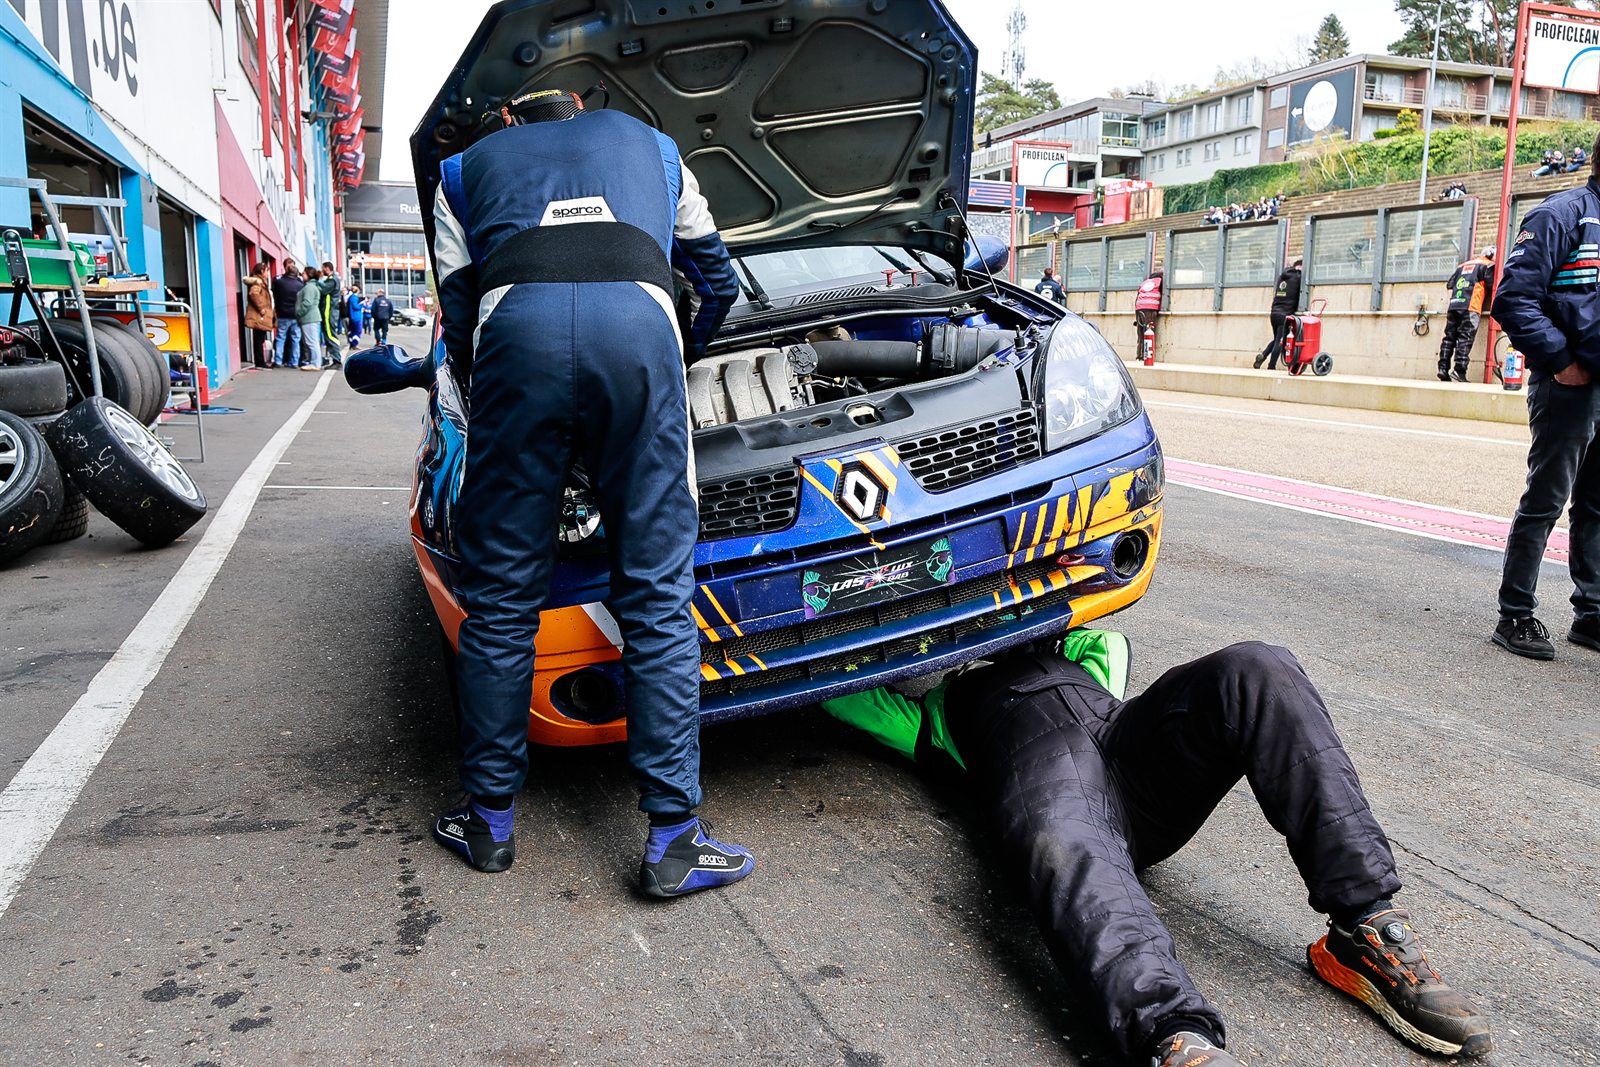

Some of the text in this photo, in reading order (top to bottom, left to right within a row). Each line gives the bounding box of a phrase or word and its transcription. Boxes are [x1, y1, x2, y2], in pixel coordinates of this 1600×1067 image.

[1535, 21, 1600, 45] PROFICLEAN
[1022, 149, 1065, 162] PROFICLEAN
[552, 206, 602, 218] sparco
[891, 561, 914, 572] LUX
[698, 854, 728, 866] sparco
